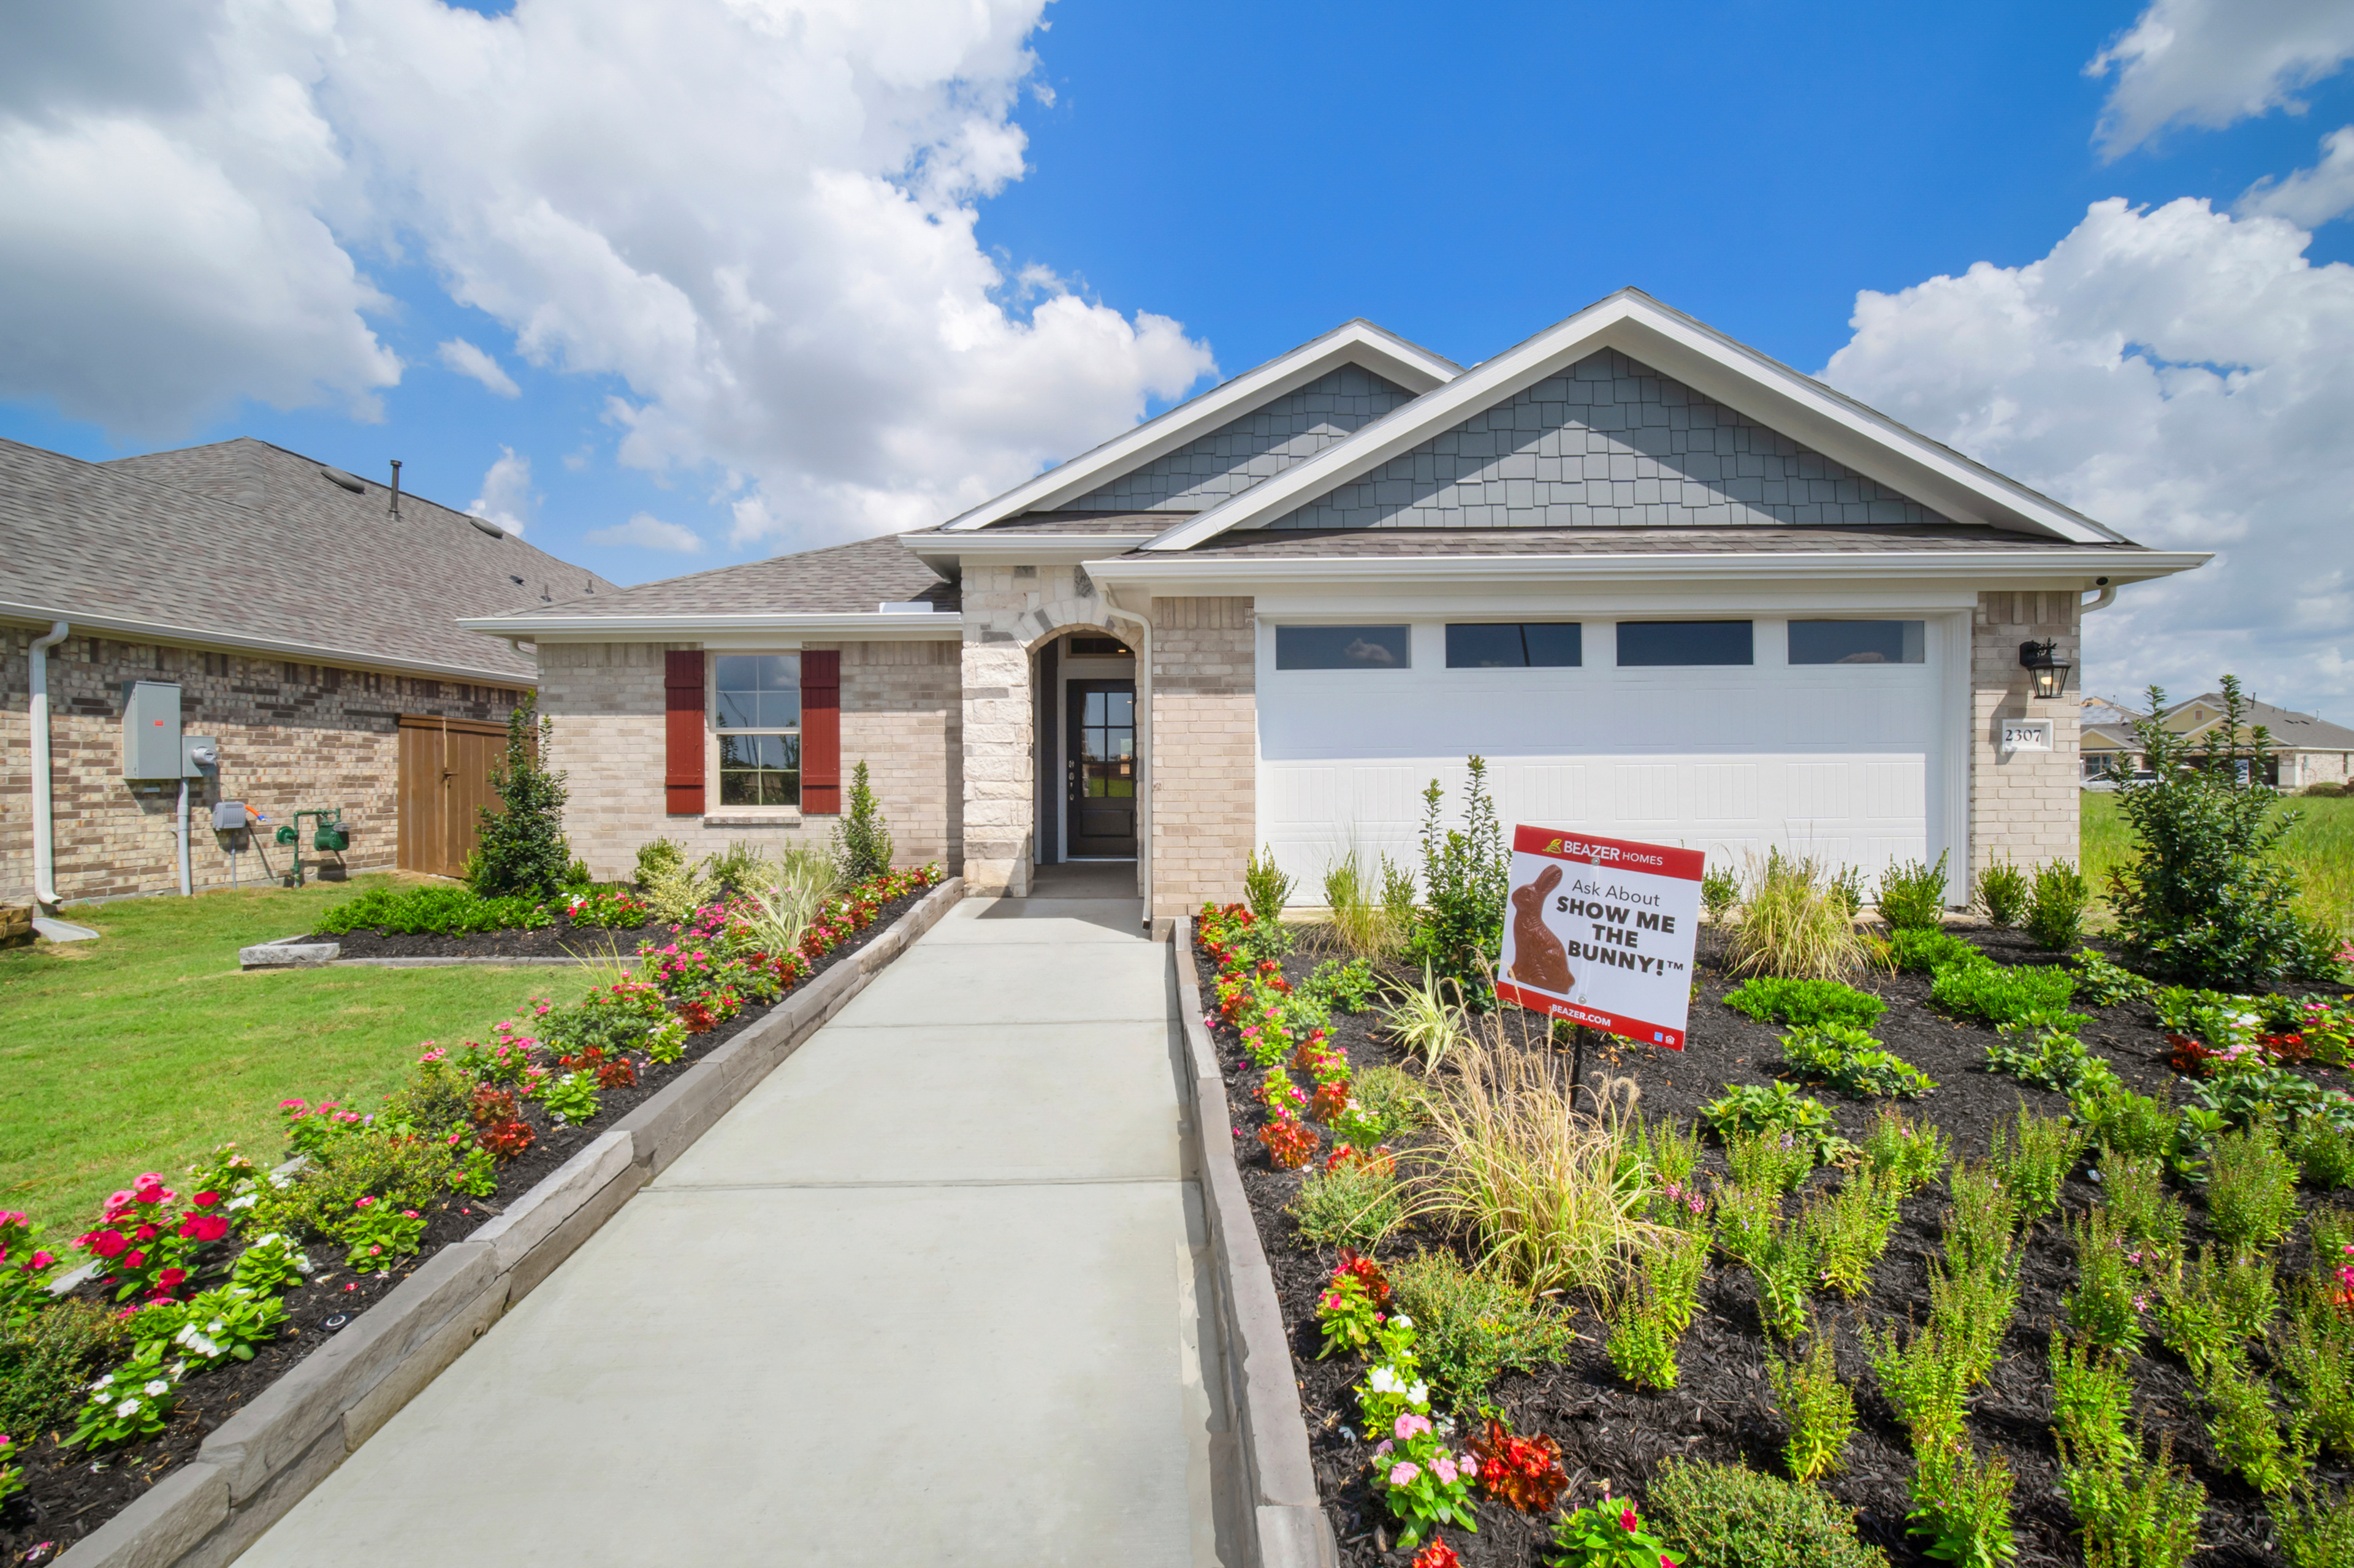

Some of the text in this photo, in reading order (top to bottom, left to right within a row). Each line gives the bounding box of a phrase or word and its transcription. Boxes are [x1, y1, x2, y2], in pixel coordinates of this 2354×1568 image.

[2005, 729, 2041, 742] 2307
[1564, 840, 1663, 866] BEAZER HOMES
[1572, 879, 1661, 907] Ask About
[1556, 896, 1675, 934] SHOW ME
[1592, 923, 1638, 948] THE
[1552, 1003, 1611, 1027] BEAZER.COM
